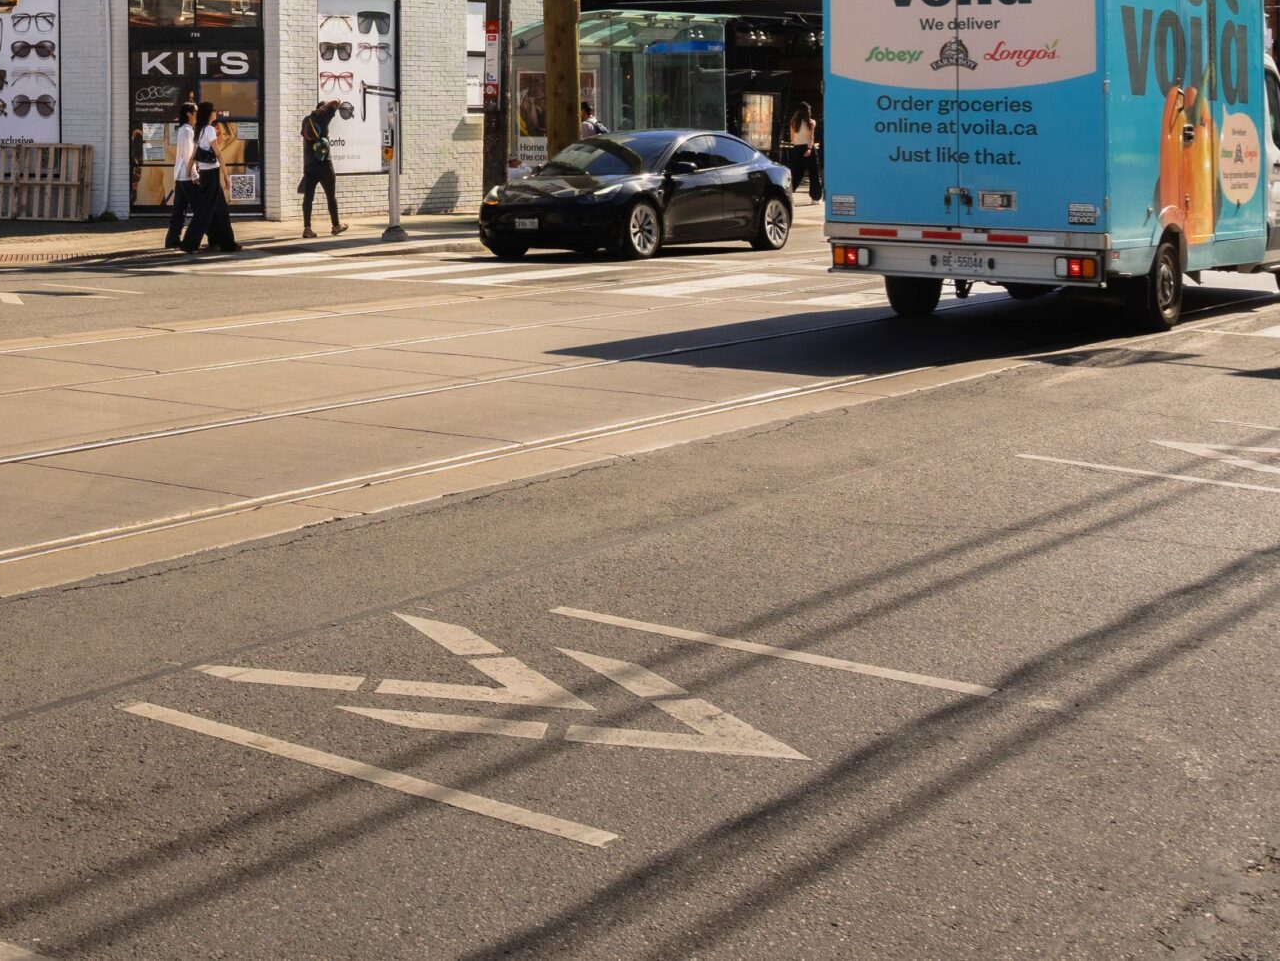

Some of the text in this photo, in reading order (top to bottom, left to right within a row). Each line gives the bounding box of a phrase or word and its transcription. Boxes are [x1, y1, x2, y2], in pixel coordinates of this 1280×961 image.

[920, 17, 1000, 31] We deliver
[141, 51, 250, 75] KITS
[865, 46, 923, 64] Sobeys
[932, 57, 957, 70] FARM
[877, 95, 1032, 115] Order groceries
[875, 118, 1038, 136] online at voila.ca
[520, 143, 544, 152] Home
[889, 146, 1021, 165] Just like that.
